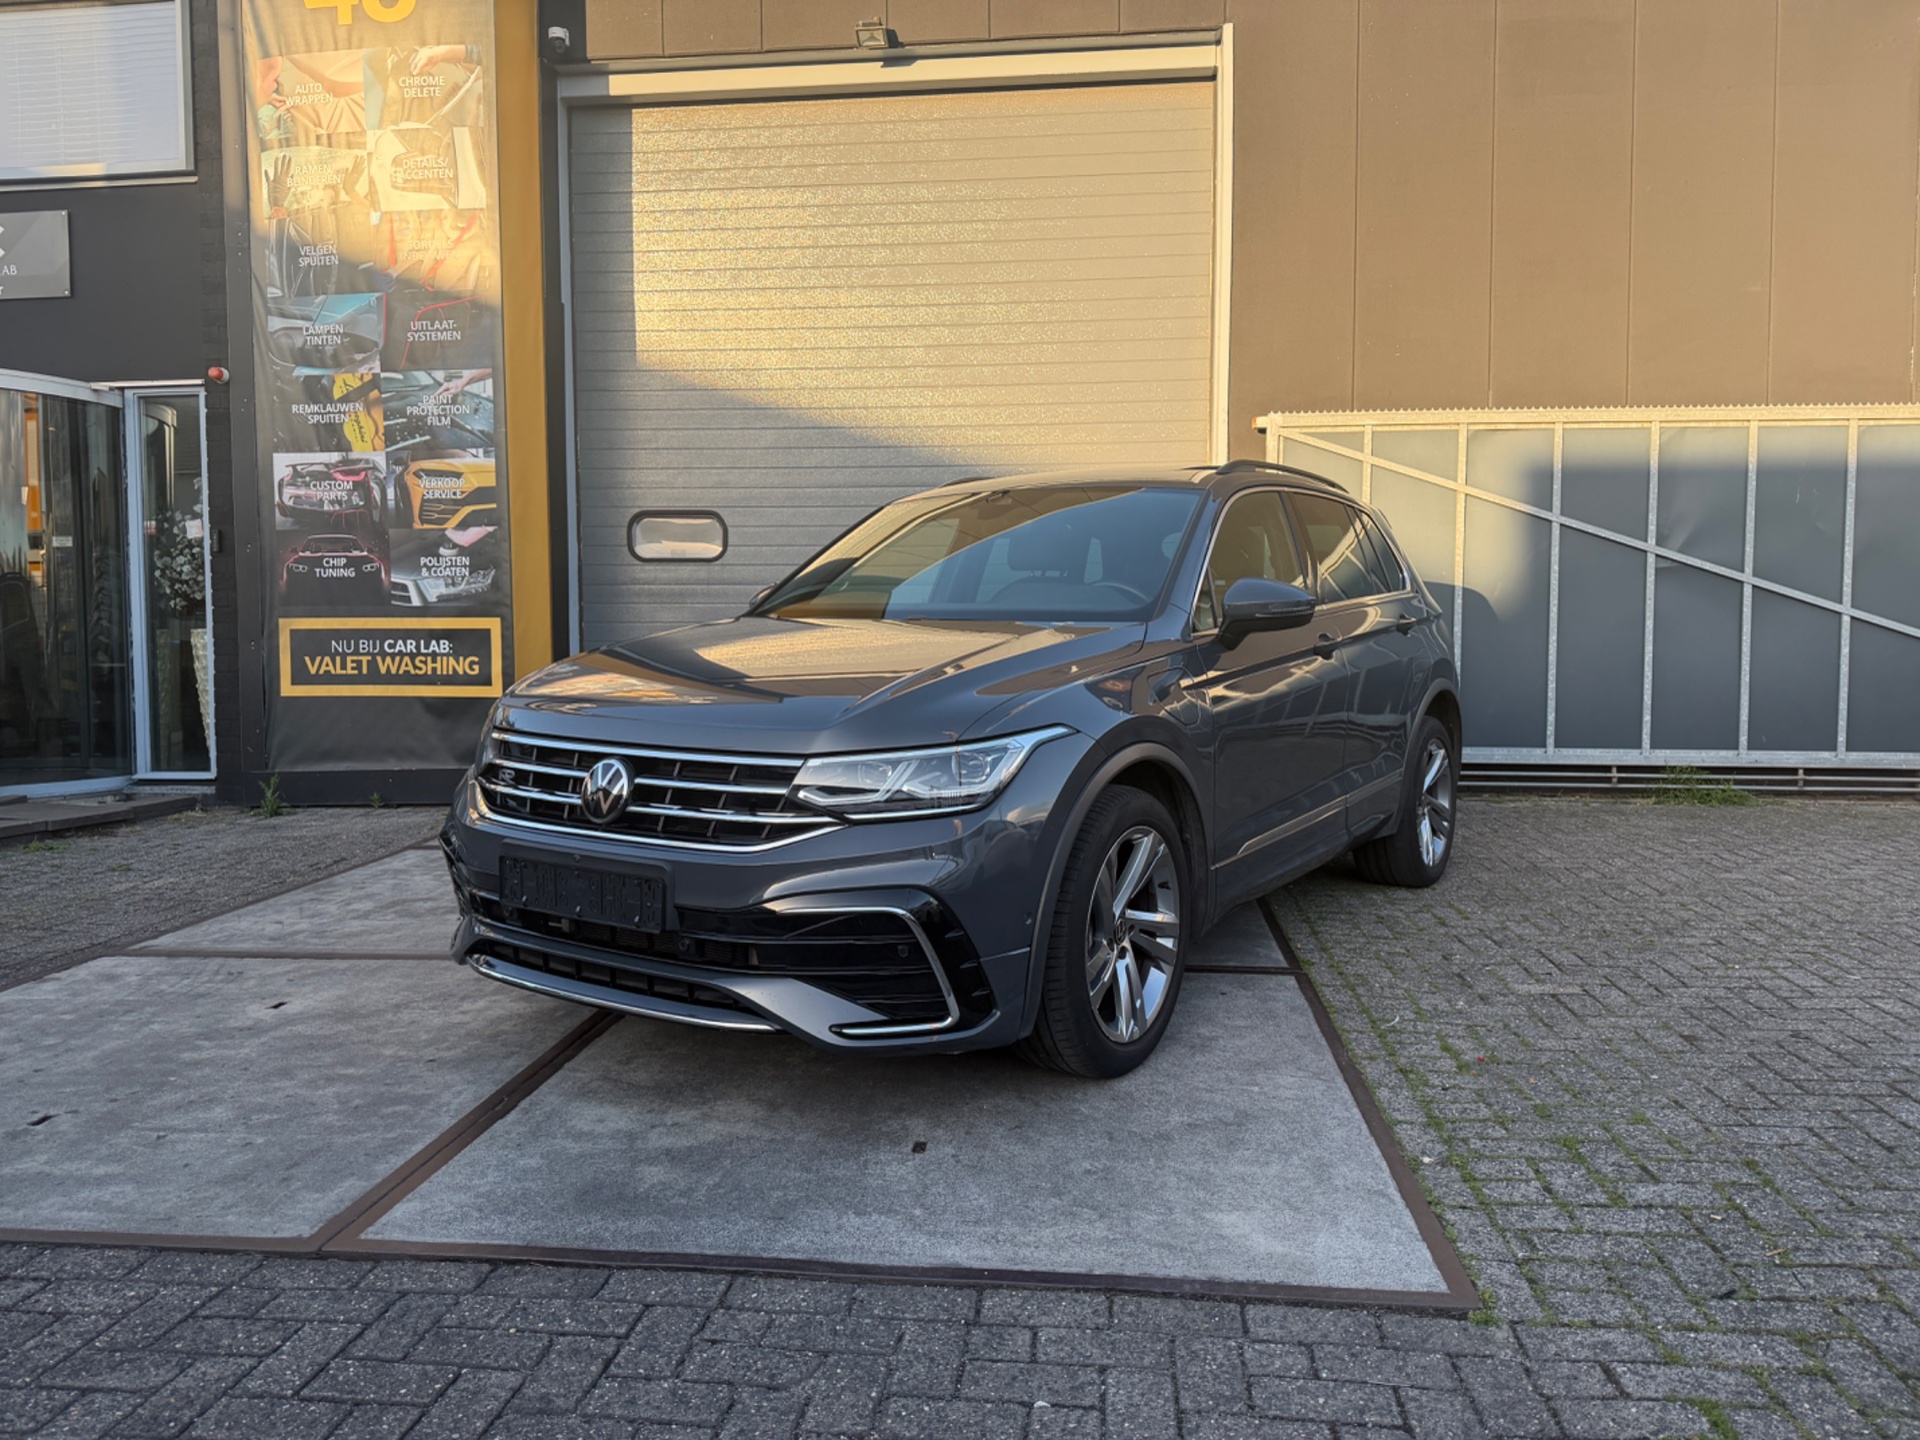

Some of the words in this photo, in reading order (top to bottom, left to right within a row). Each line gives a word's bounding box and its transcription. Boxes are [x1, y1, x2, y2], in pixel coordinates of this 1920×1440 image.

[399, 76, 445, 87] CHROME
[295, 83, 322, 95] AUTO
[404, 87, 442, 98] DELETE
[285, 93, 333, 106] WRAPPEN
[402, 157, 448, 168] DETAILS/
[295, 163, 332, 175] RAMEN
[400, 168, 453, 180] ACCENTEN
[300, 244, 337, 256] VELGEN
[399, 250, 459, 261] INBOWEN
[299, 255, 339, 267] SPUITEN
[0, 264, 17, 276] AB
[303, 324, 344, 335] LAMPEN
[410, 320, 457, 331] UITLAAT-
[306, 335, 341, 345] TINTEN
[407, 330, 461, 342] SYSTEMEN
[422, 394, 453, 404] PAINT
[292, 402, 364, 414] REMKLAUWEN
[406, 404, 470, 416] PROTECTION
[308, 413, 349, 424] SPUITEN
[427, 416, 451, 427] FILM
[310, 480, 353, 491] CUSTOM
[419, 478, 465, 489] VERKOOP
[316, 490, 348, 501] PARTS
[423, 488, 462, 500] SERVICE
[323, 557, 347, 568] CHIP
[420, 556, 470, 569] POLIJSTEN
[314, 567, 355, 578] TUNING
[421, 567, 429, 577] &
[431, 566, 469, 577] COATEN
[331, 640, 354, 653] NU
[359, 639, 380, 653] BIJ
[384, 639, 417, 653] CAR
[420, 639, 453, 653] LAB:
[304, 655, 371, 675] VALET
[376, 655, 480, 675] WASHING
